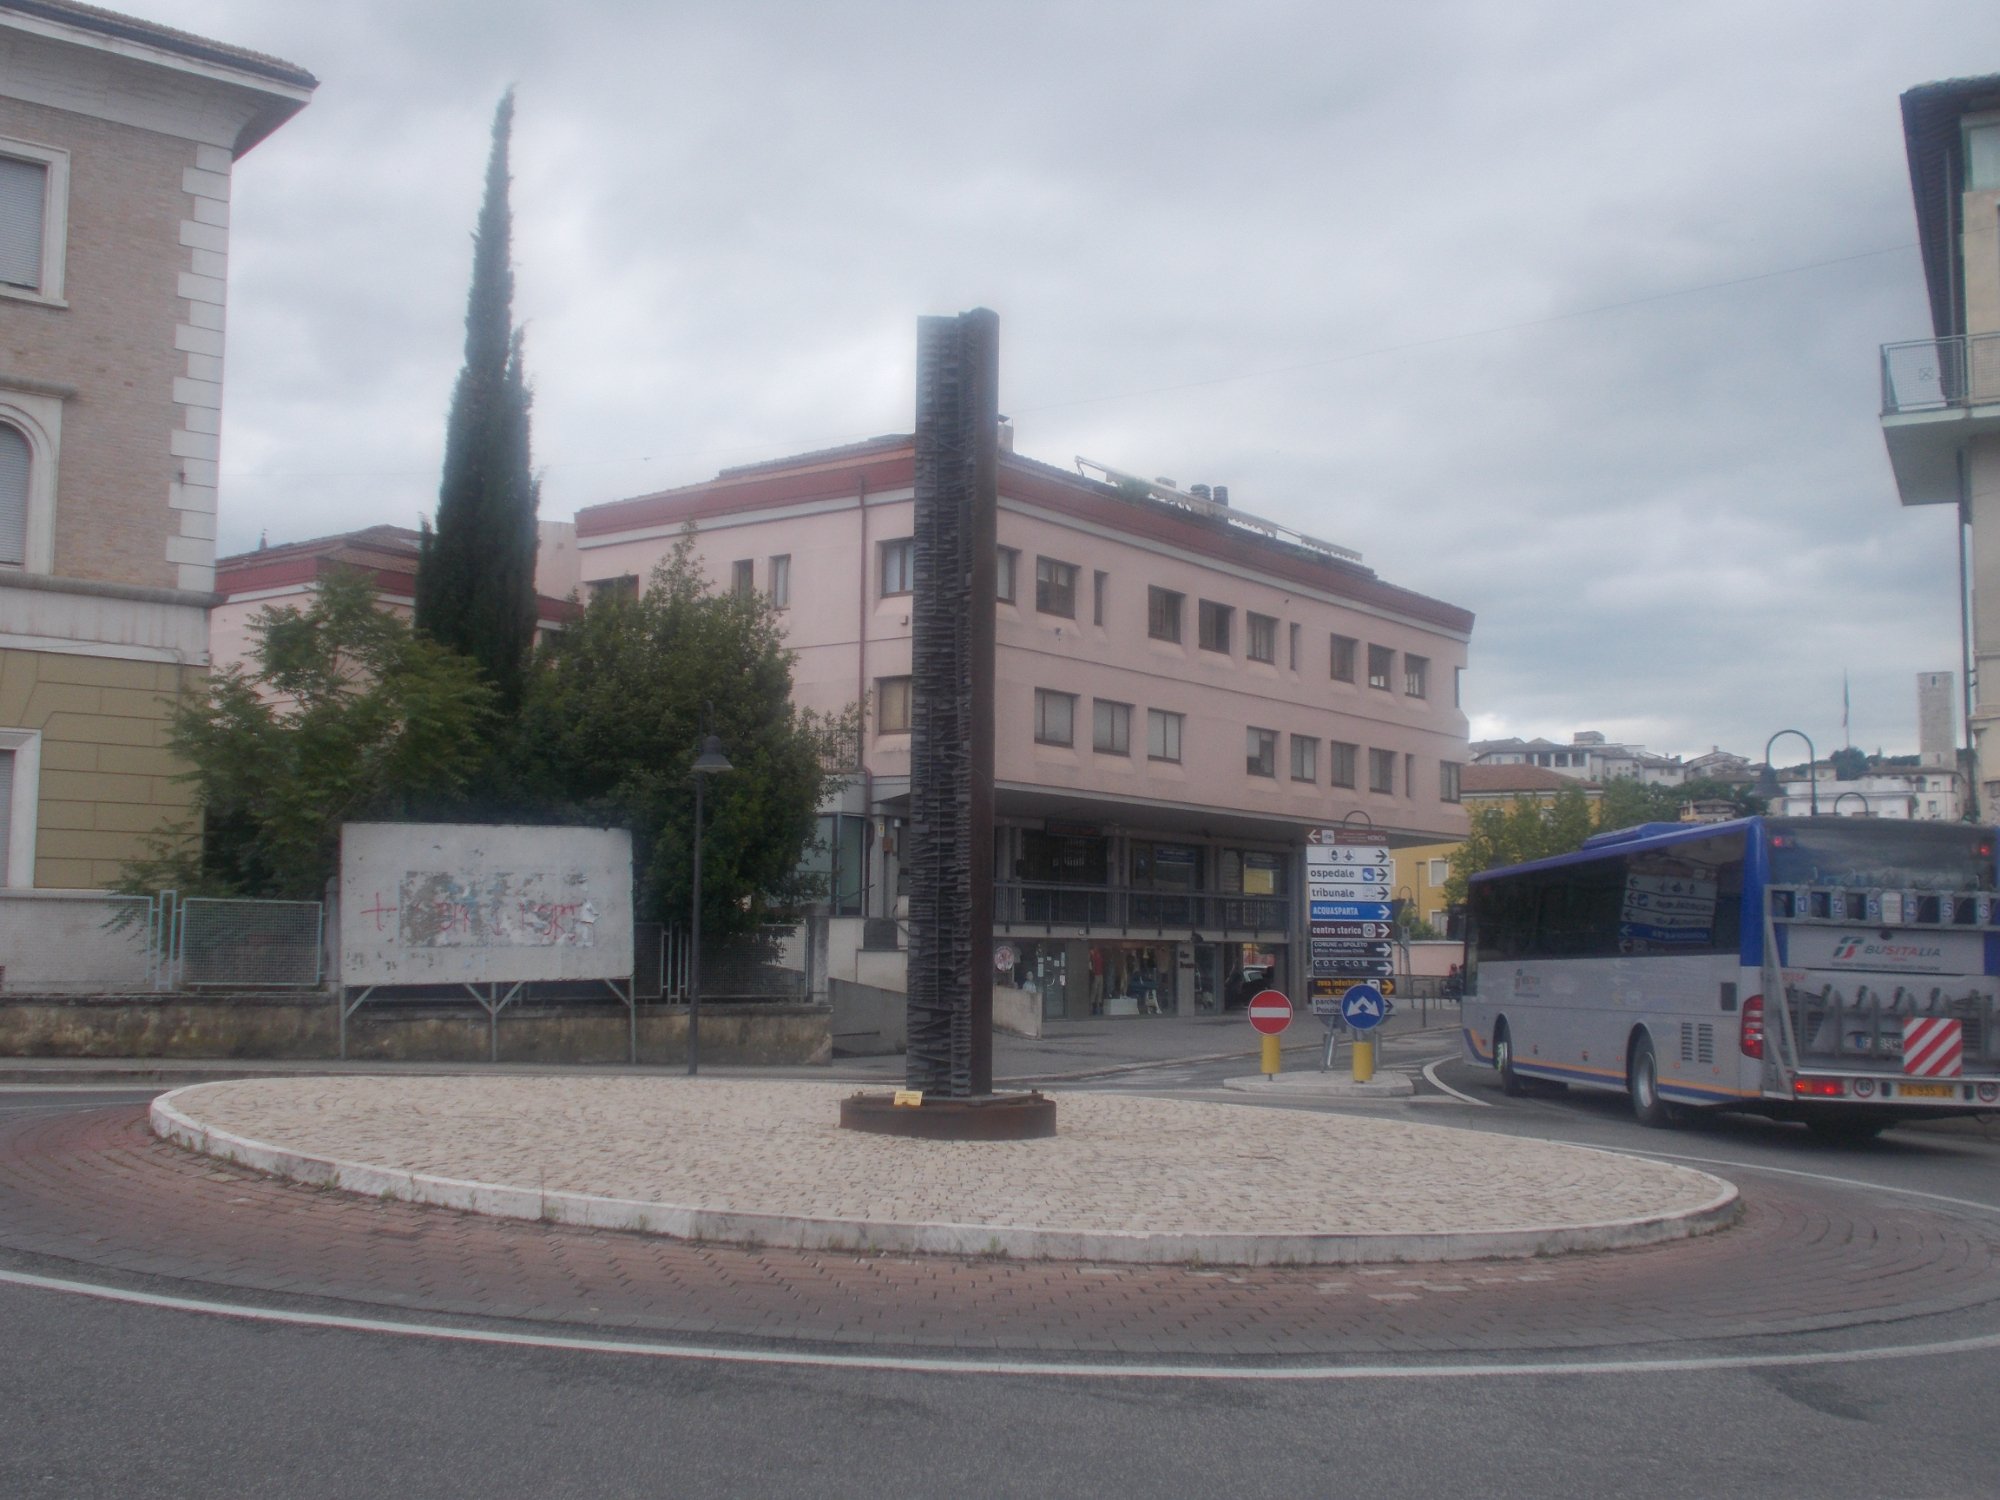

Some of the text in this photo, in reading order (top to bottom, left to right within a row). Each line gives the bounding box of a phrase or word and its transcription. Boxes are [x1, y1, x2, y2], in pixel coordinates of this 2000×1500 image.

[1310, 869, 1355, 879] ospedale
[1311, 888, 1355, 898] tribunale
[1312, 906, 1359, 915] ACQUASPARTA
[1312, 926, 1361, 934] centro storico
[1864, 945, 1941, 957] BUSITALIA
